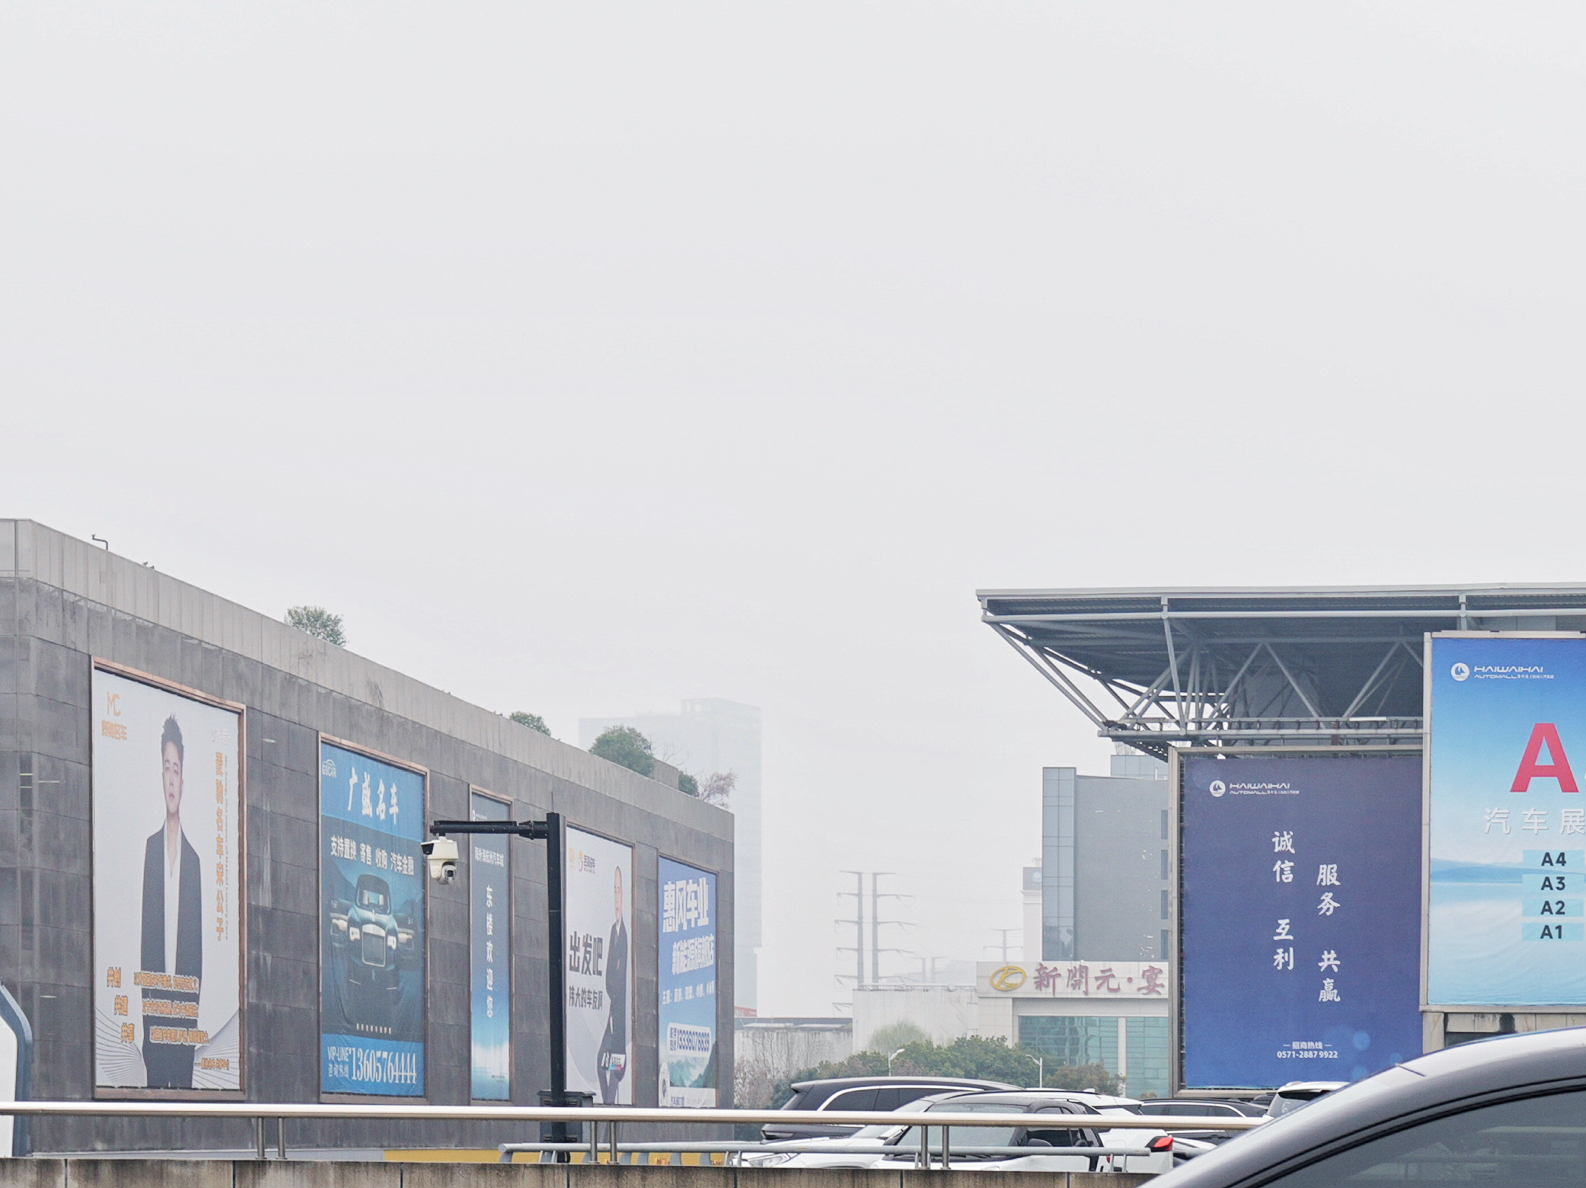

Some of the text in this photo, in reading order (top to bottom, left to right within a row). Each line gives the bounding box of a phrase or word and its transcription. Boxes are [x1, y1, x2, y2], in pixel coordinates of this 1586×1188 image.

[330, 834, 357, 861] 支持置换
[375, 847, 388, 870] 收购
[390, 852, 415, 876] 汽车金融
[1541, 852, 1567, 867] A4
[1541, 876, 1566, 891] A3
[662, 877, 709, 933] 惠风车业
[1272, 831, 1296, 971] 诚信 互利
[1540, 900, 1566, 915] A2
[1316, 863, 1341, 1003] 服务 共赢
[1540, 925, 1563, 940] A1
[569, 931, 604, 977] 出发吧
[1291, 1041, 1323, 1050] 招商热线
